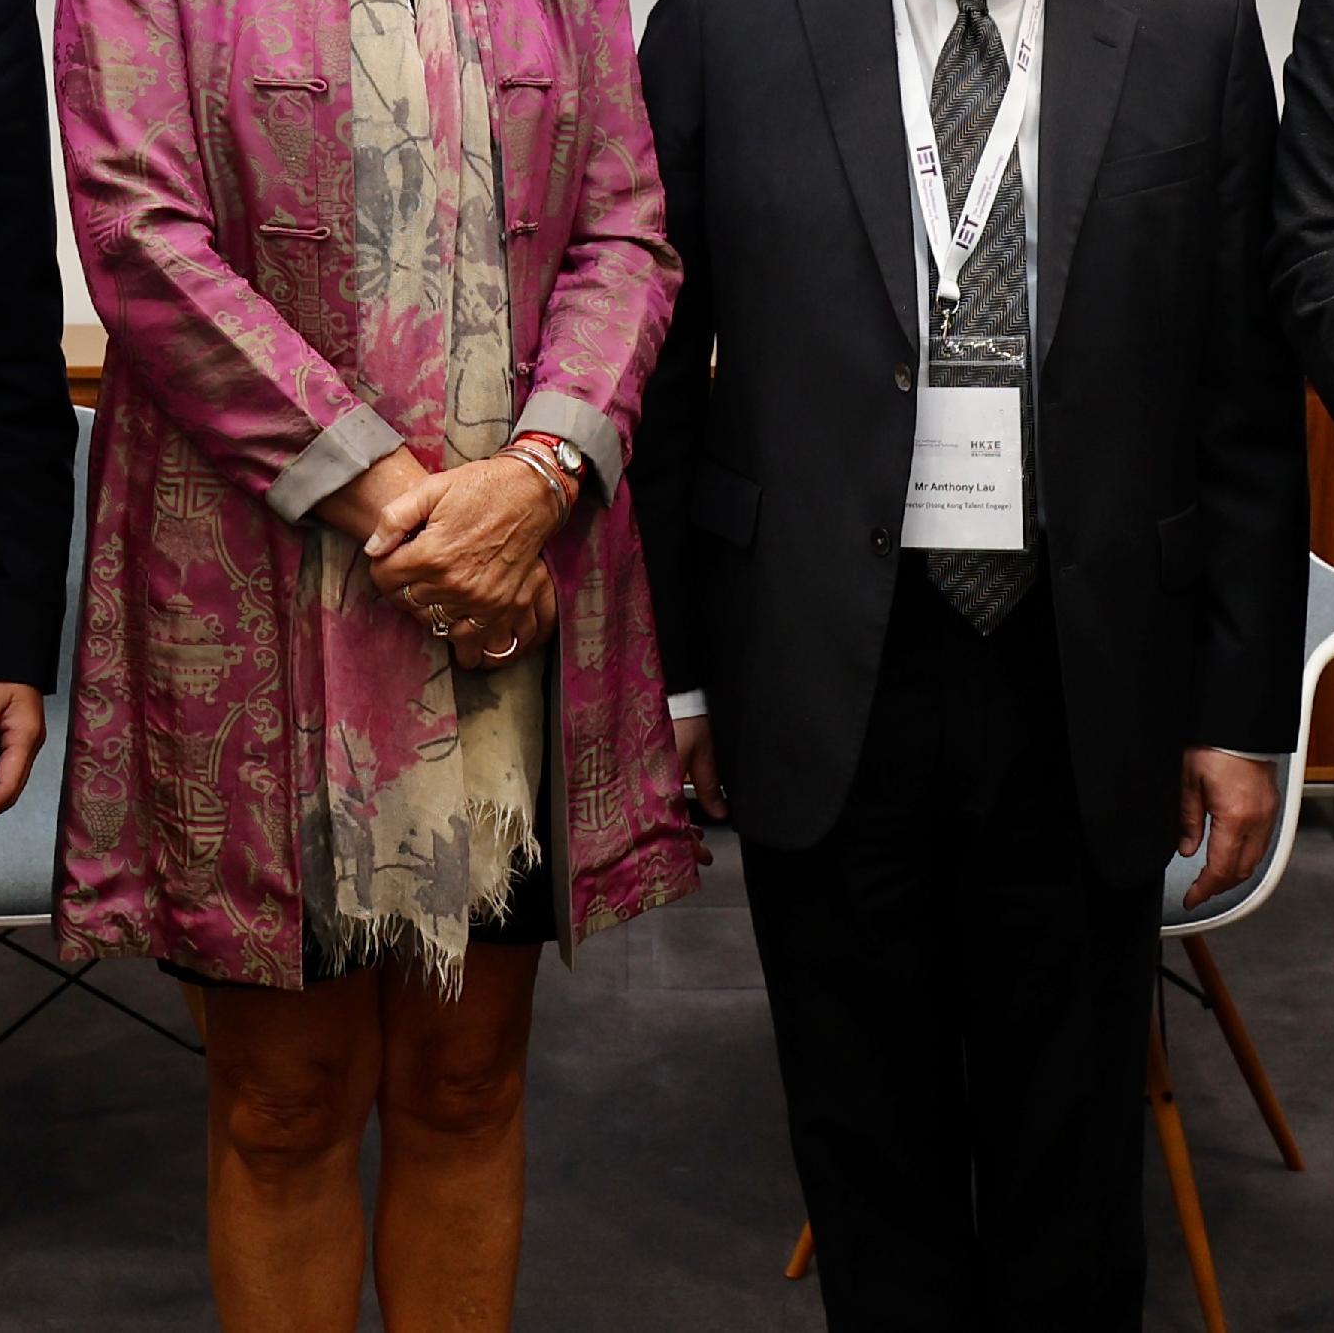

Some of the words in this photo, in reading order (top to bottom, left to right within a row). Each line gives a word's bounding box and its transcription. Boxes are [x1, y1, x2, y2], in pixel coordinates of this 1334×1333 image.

[1017, 38, 1031, 72] IET
[916, 145, 937, 176] IET
[956, 214, 978, 250] IET
[915, 482, 928, 490] Mr
[930, 482, 974, 494] Anthony
[977, 483, 995, 492] Lau
